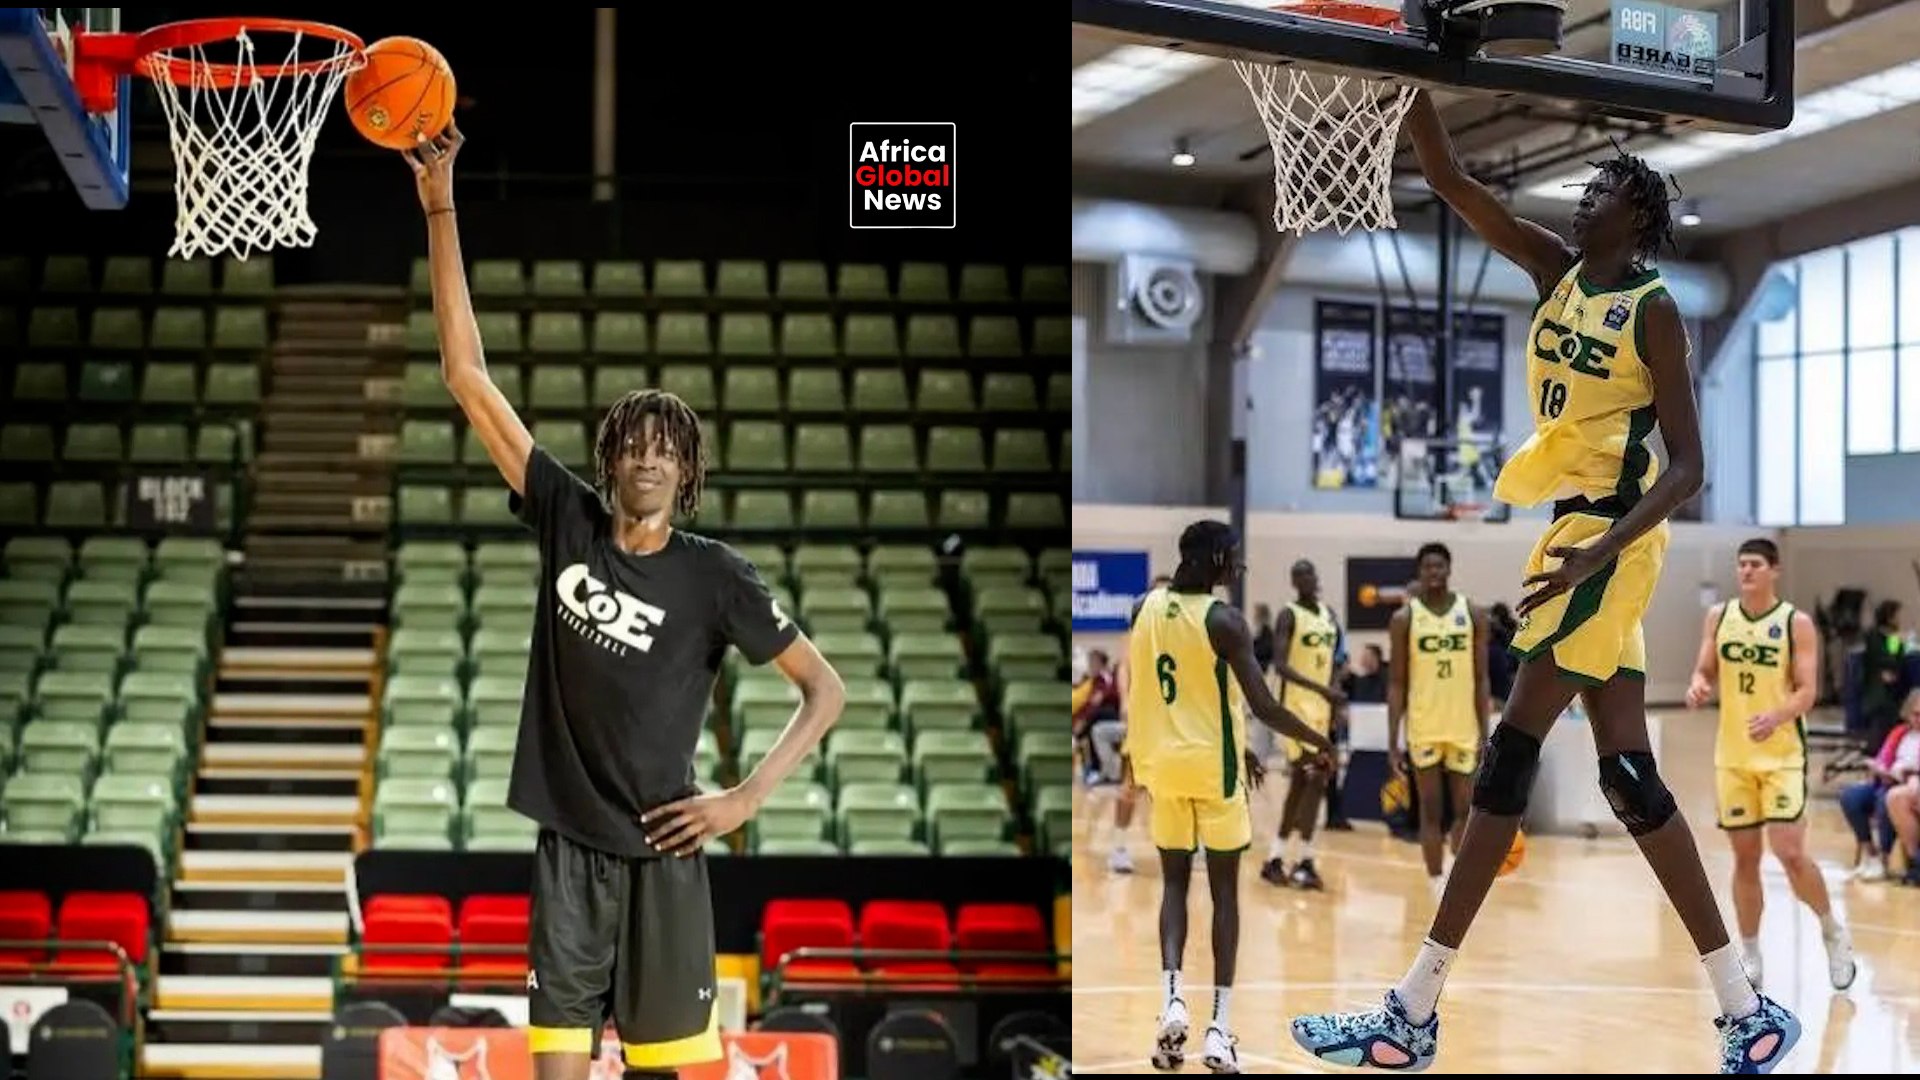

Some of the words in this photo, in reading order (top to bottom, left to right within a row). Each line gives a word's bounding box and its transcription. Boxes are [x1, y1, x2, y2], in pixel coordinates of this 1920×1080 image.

[1540, 379, 1567, 420] 18
[138, 476, 204, 500] BLOCK
[557, 603, 627, 657] BASKETBALL
[1156, 653, 1177, 705] 6
[1437, 660, 1451, 679] 21
[1739, 671, 1755, 694] 12
